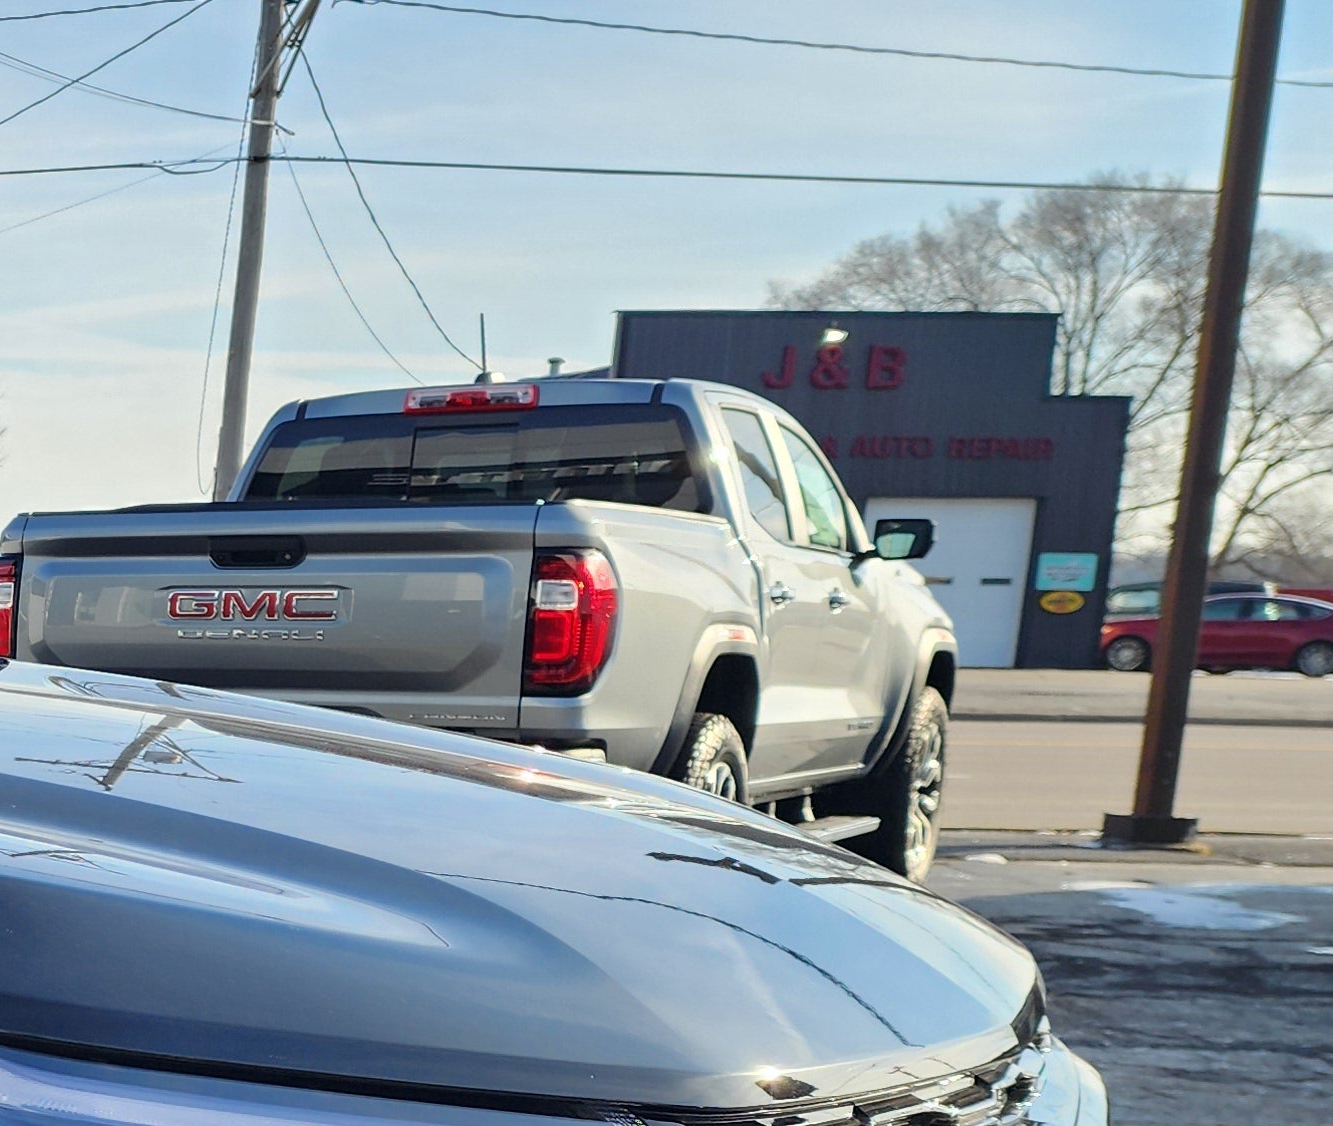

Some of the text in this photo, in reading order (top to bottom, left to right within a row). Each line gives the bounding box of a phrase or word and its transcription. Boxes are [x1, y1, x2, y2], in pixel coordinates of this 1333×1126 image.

[849, 436, 933, 459] AUTO
[947, 436, 1054, 461] REPAIR
[167, 590, 339, 621] GMC
